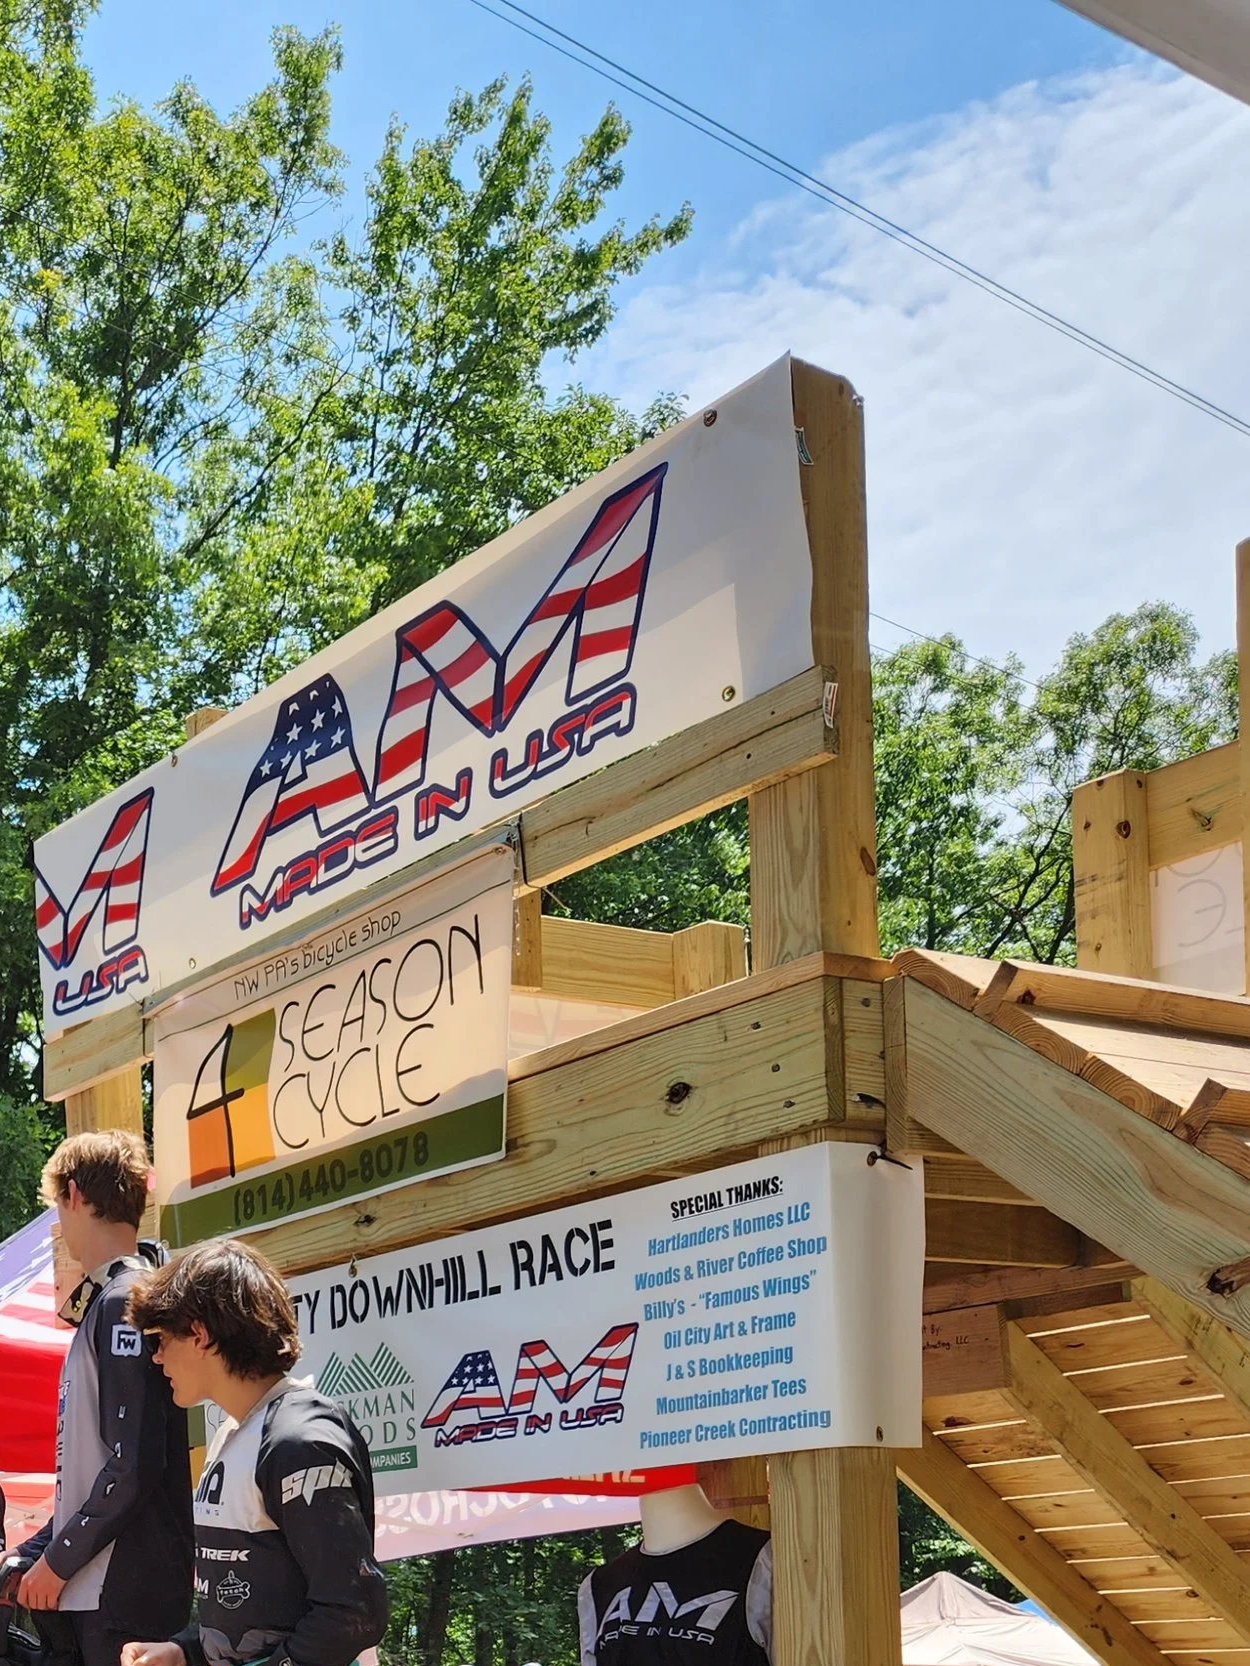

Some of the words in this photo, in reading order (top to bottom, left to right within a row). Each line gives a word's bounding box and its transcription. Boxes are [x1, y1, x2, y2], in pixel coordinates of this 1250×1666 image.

[210, 461, 668, 896] AM
[239, 807, 398, 929] MADE
[415, 767, 472, 840] IN
[489, 682, 637, 797] USA
[53, 945, 149, 1016] USA
[234, 976, 259, 1000] NW
[265, 956, 299, 988] PA's
[303, 927, 357, 969] bicycle
[361, 910, 401, 942] shop
[279, 914, 484, 1072] SEASON
[186, 1023, 245, 1178] 4
[273, 1023, 440, 1149] CYCLE
[671, 1191, 724, 1218] SPECIAL
[727, 1176, 783, 1204] THANKS:
[648, 1222, 729, 1256] Hartlanders
[733, 1212, 783, 1236] Homes
[787, 1202, 810, 1225] LLC
[331, 1250, 501, 1329] DOWNHILL
[510, 1219, 615, 1290] RACE
[635, 1266, 680, 1291] Woods
[685, 1264, 693, 1281] &
[697, 1256, 734, 1278] River
[738, 1244, 783, 1270] Coffee
[788, 1236, 827, 1260] Shop
[644, 1299, 685, 1321] Billy's
[664, 1331, 681, 1349] Oil
[685, 1327, 711, 1346] City
[714, 1322, 734, 1341] Art
[738, 1320, 747, 1336] &
[751, 1311, 796, 1334] Frame
[421, 1322, 639, 1428] AM
[666, 1364, 671, 1381] J
[675, 1363, 684, 1380] &
[687, 1361, 695, 1378] S
[699, 1346, 793, 1376] Bookkeeping
[656, 1384, 768, 1415] Mountainbarker
[772, 1379, 806, 1398] Tees
[435, 1419, 519, 1448] MADE
[524, 1413, 552, 1435] IN
[560, 1403, 624, 1430] USA
[640, 1429, 692, 1449] Pioneer
[695, 1421, 735, 1442] Creek
[739, 1409, 831, 1437] Contracting
[200, 1548, 250, 1561] TREK
[597, 1581, 740, 1637] AM
[647, 1626, 661, 1636] IN
[668, 1627, 715, 1645] USA
